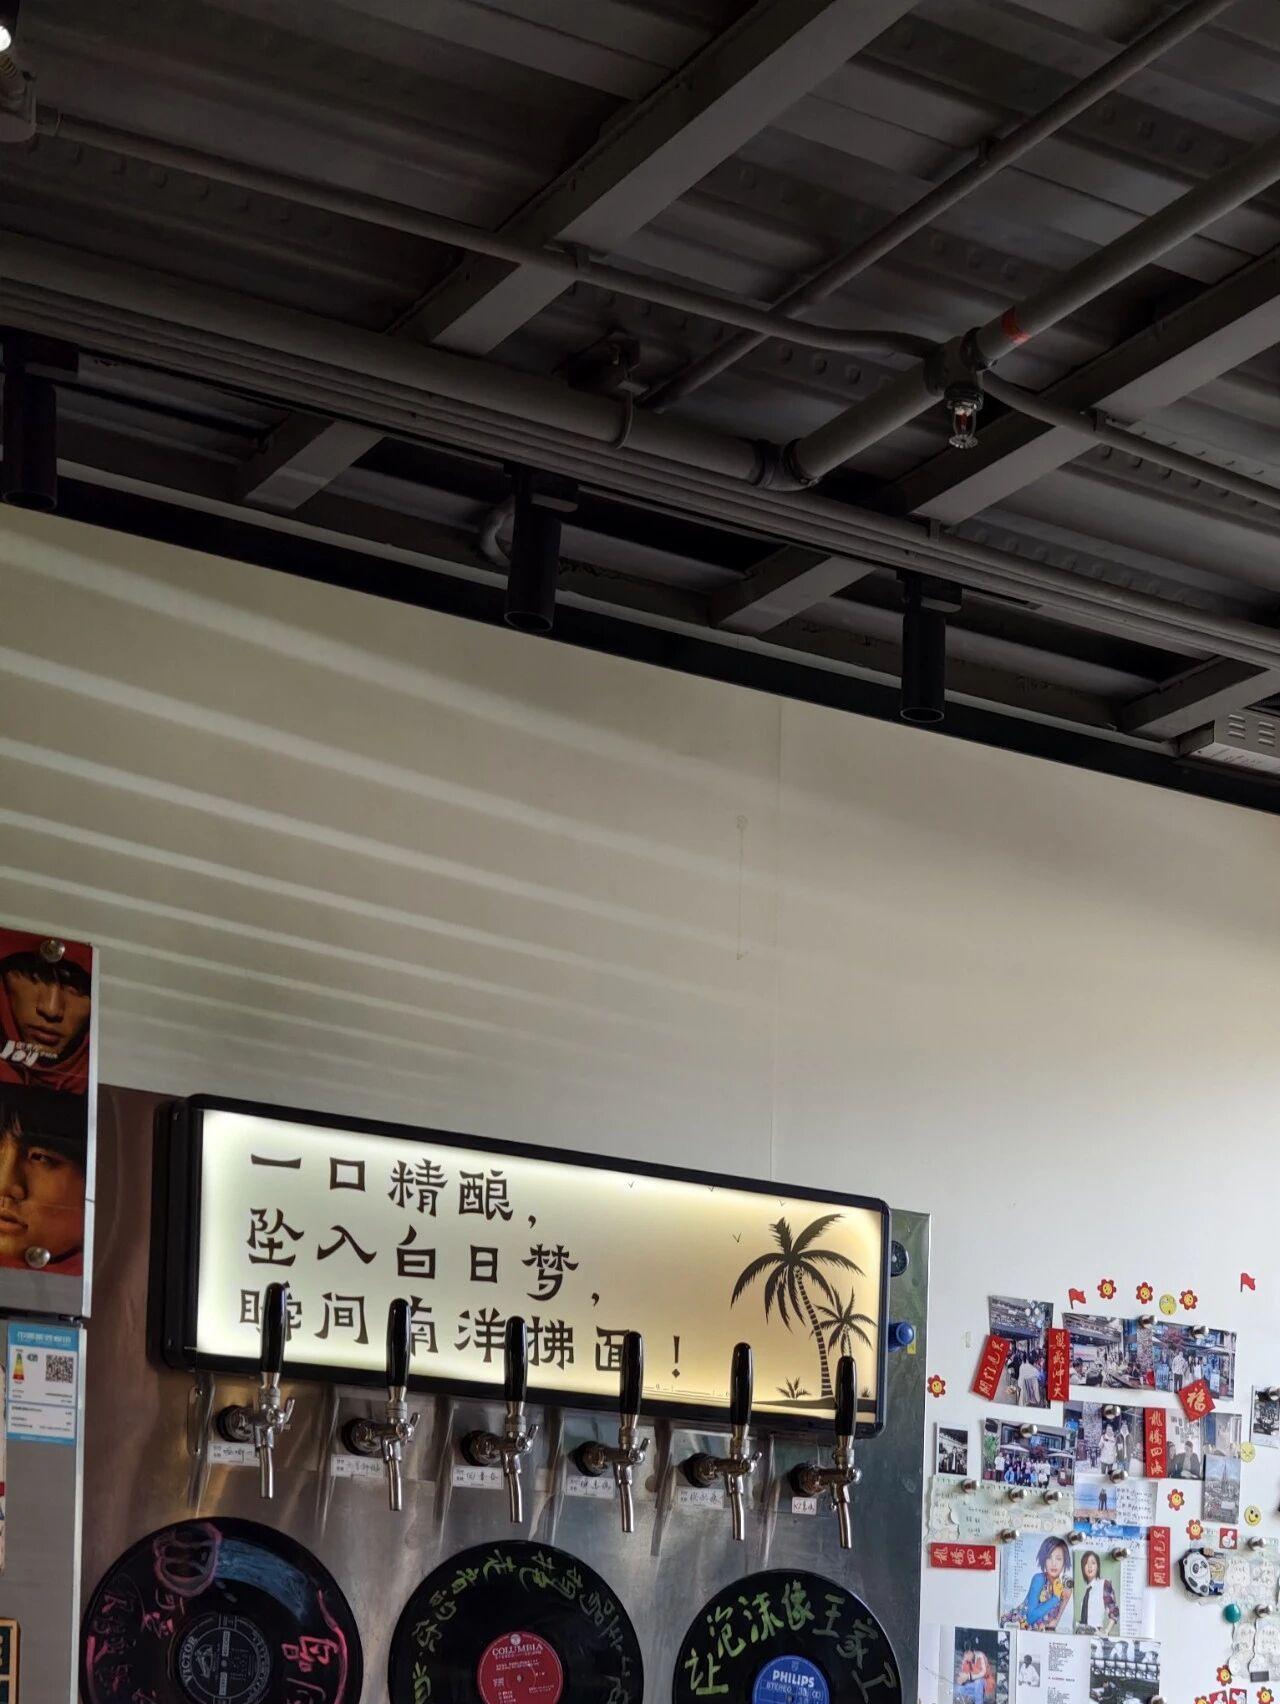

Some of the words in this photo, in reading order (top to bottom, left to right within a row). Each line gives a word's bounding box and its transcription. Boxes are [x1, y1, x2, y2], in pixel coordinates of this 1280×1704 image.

[1187, 1387, 1207, 1412] 福
[181, 1635, 199, 1686] VICTOR
[491, 1643, 544, 1657] COLUMBIA
[772, 1669, 815, 1688] PHILIPS
